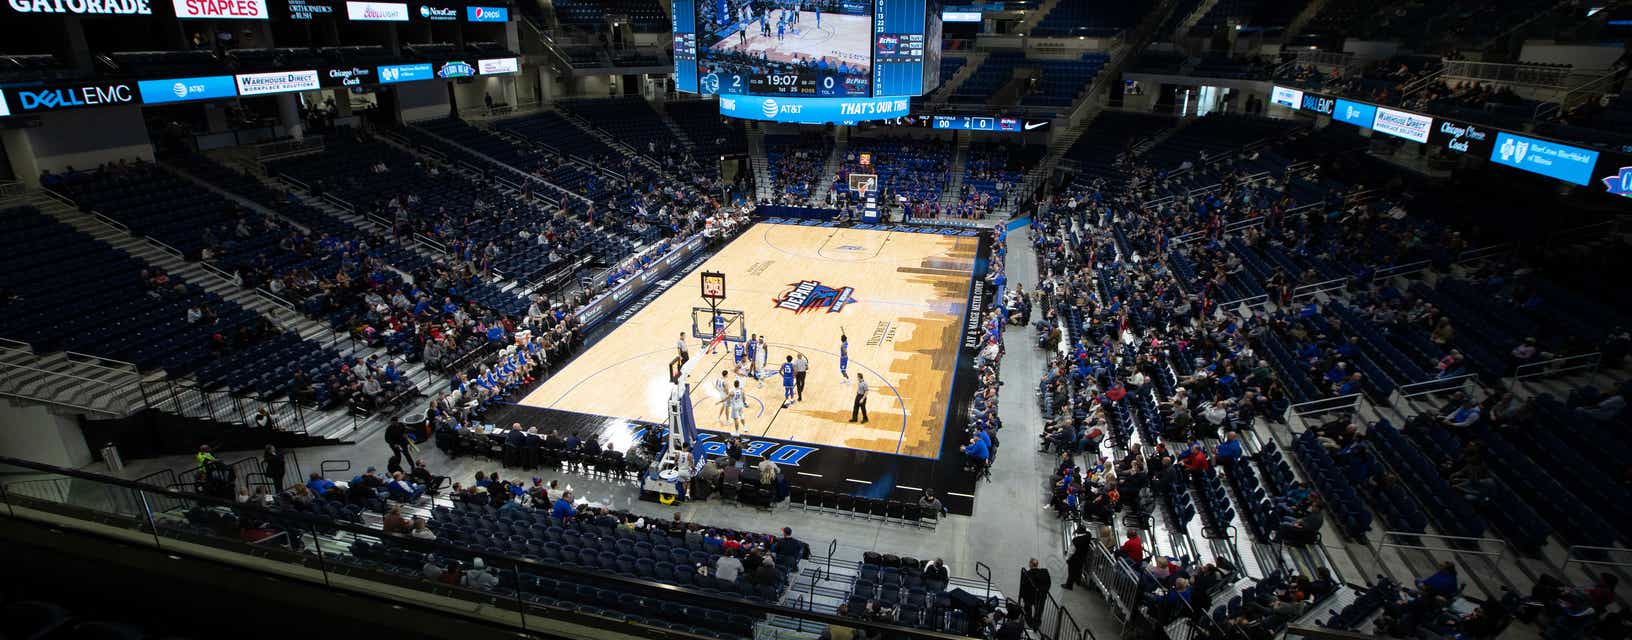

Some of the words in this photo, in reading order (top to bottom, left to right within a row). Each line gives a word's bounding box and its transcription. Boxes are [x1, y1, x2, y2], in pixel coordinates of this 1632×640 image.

[187, 0, 258, 15] STAPLES
[429, 7, 457, 16] NovaCare
[484, 11, 501, 19] pepsi
[329, 68, 352, 78] Chicago
[242, 76, 287, 86] WAREHOUSE
[288, 74, 312, 83] DIRECT
[342, 77, 361, 86] Coach
[732, 75, 741, 87] 2
[766, 75, 798, 86] 19:07
[824, 76, 834, 89] 0
[780, 104, 802, 113] AT&T
[840, 103, 876, 115] THAT'S
[876, 101, 893, 112] OUR
[939, 120, 950, 128] 00
[964, 121, 970, 129] 4
[980, 119, 986, 128] 0
[1441, 121, 1466, 138] Chicago
[1449, 138, 1469, 152] Coach
[974, 280, 983, 295] COURT
[780, 280, 819, 311] DEPAUL
[970, 294, 981, 311] MEYER
[968, 311, 979, 330] MARGE
[965, 335, 976, 347] RAY
